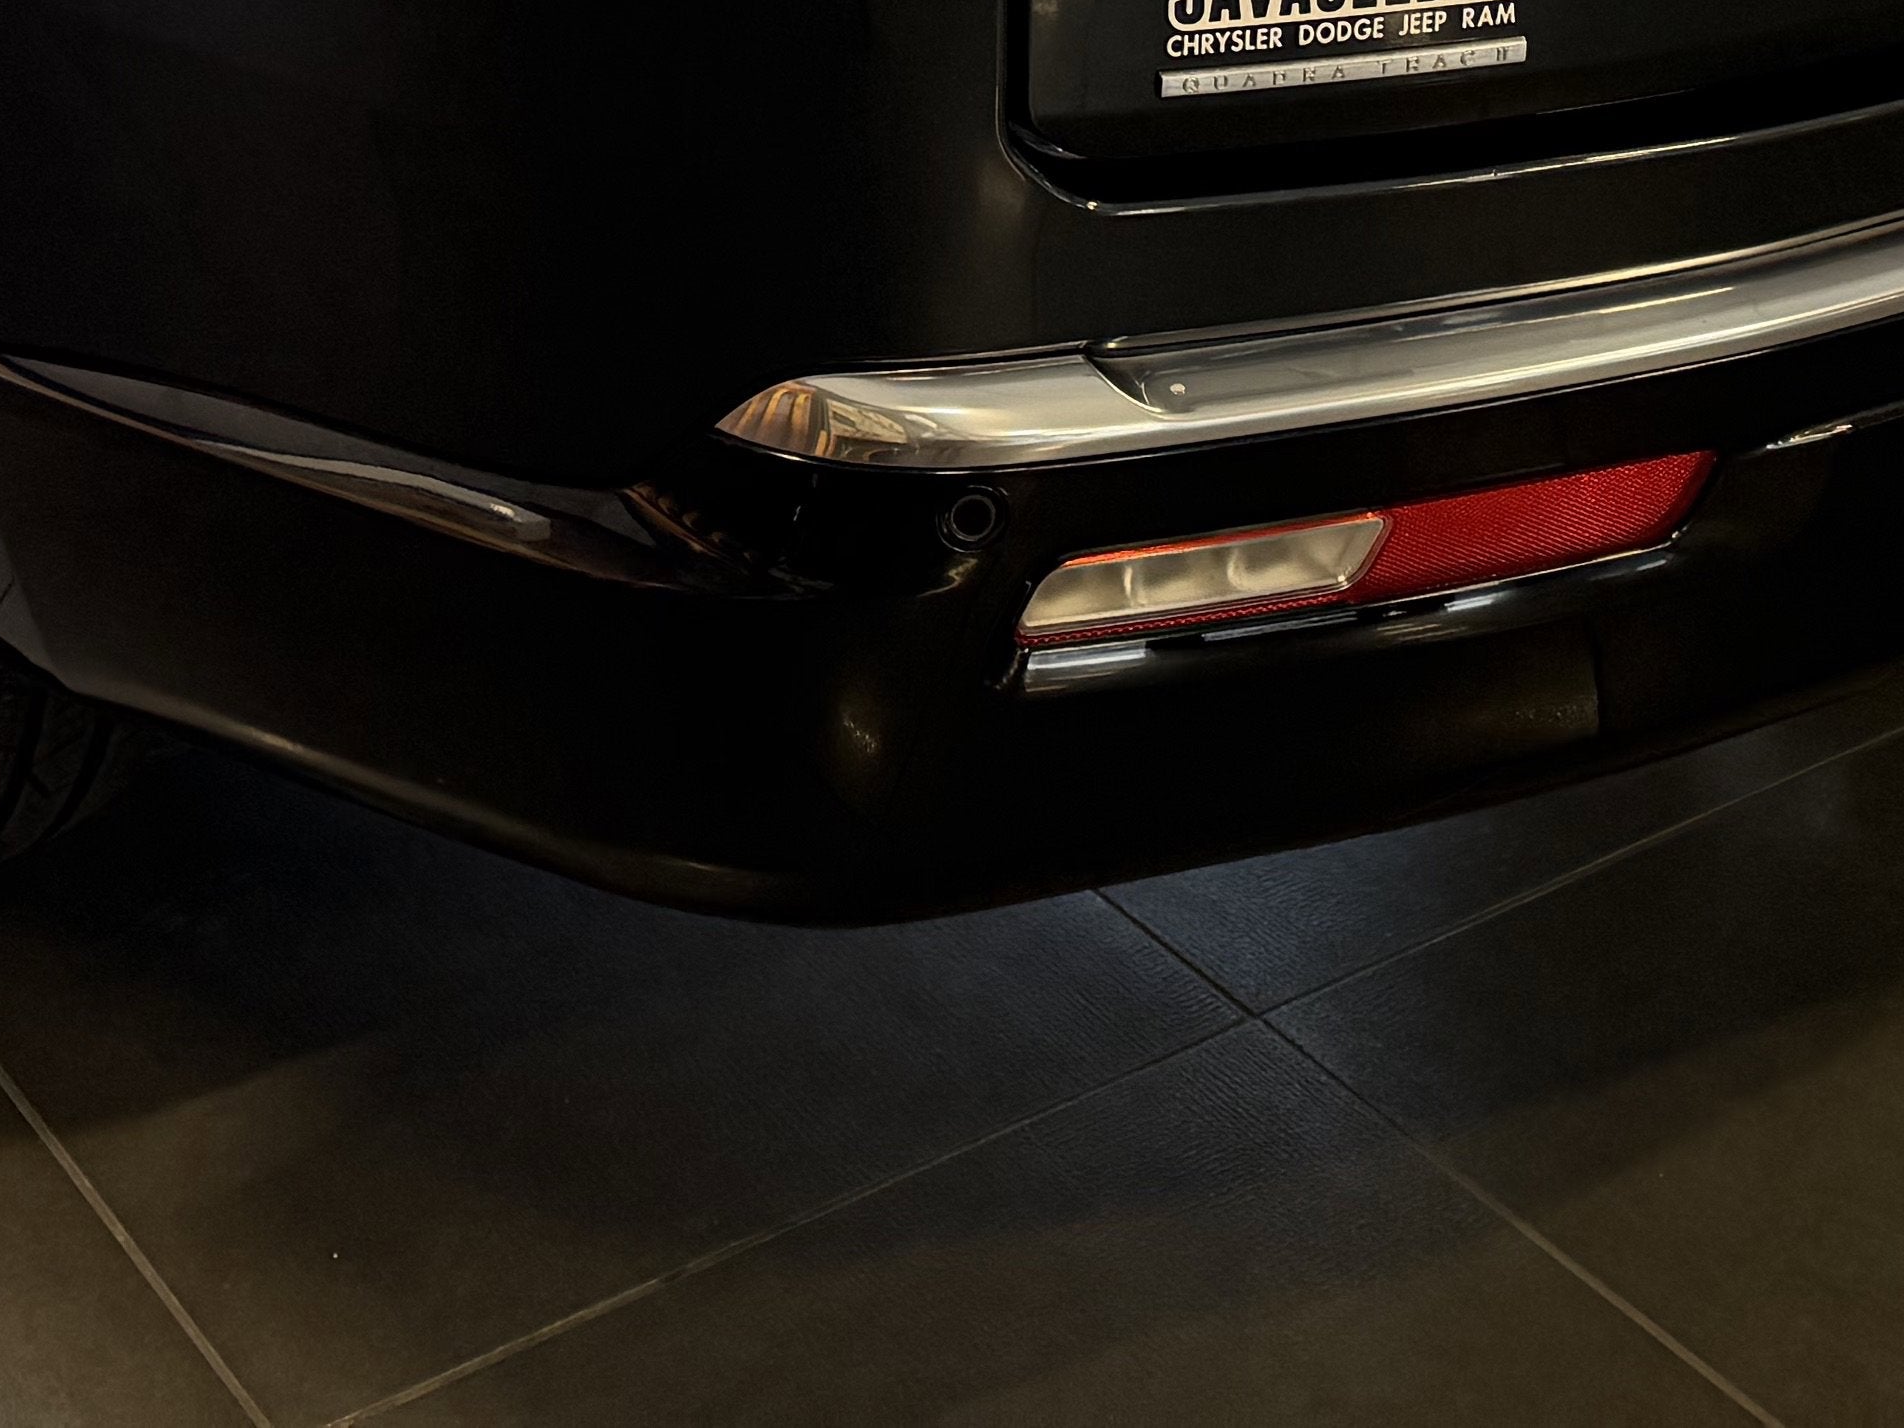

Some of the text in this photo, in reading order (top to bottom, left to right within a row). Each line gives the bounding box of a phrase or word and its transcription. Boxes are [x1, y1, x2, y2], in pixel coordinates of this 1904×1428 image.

[1165, 2, 1517, 59] CHRYSLER DODGE JEEP RAM
[1181, 66, 1346, 94] QUADRA
[1376, 49, 1477, 76] TRAC
